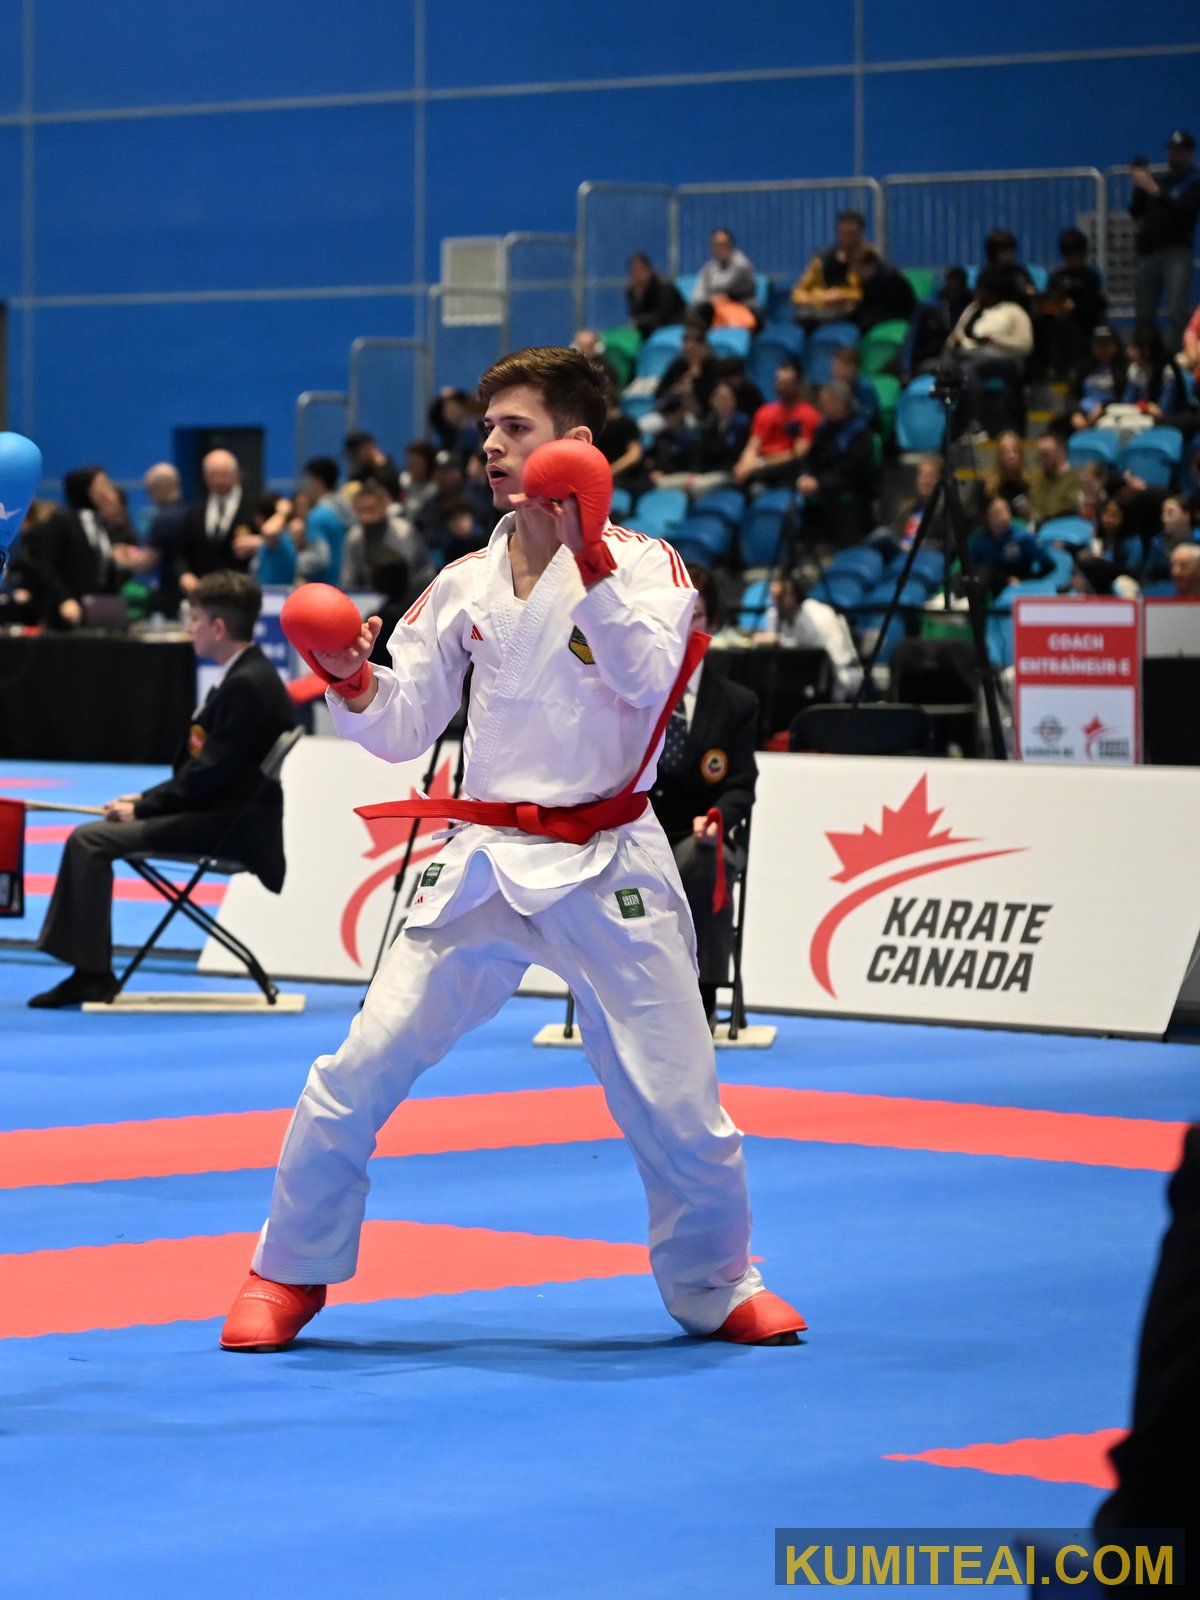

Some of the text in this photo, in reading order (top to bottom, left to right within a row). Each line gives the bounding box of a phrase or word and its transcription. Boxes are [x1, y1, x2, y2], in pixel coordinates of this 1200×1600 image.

[1047, 632, 1104, 651] COACH
[882, 897, 1054, 944] KARATE
[866, 943, 1034, 993] CANADA
